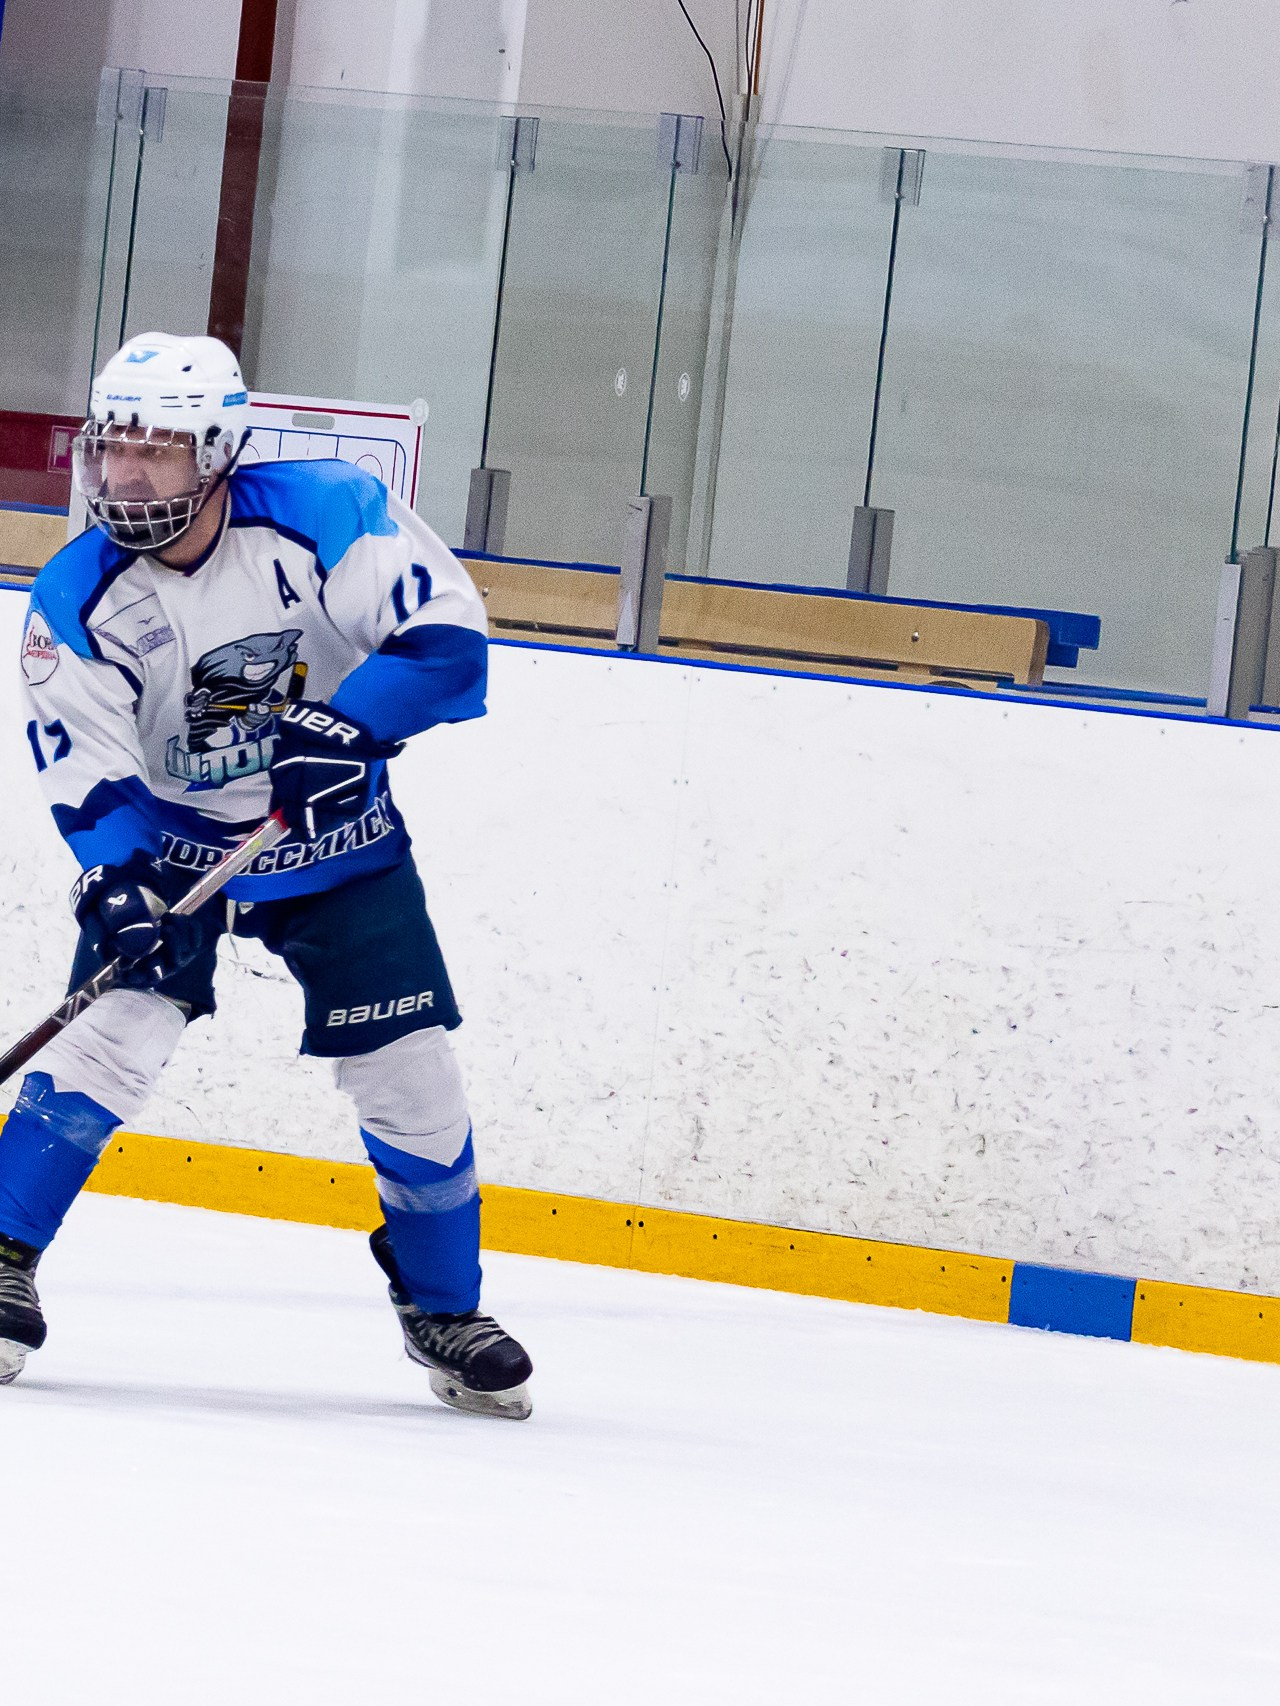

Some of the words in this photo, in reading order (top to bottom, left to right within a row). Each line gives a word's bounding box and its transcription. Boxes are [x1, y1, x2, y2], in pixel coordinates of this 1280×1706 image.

[273, 558, 302, 610] A
[26, 718, 73, 773] 17
[281, 703, 360, 747] UER
[326, 990, 434, 1027] BAUER
